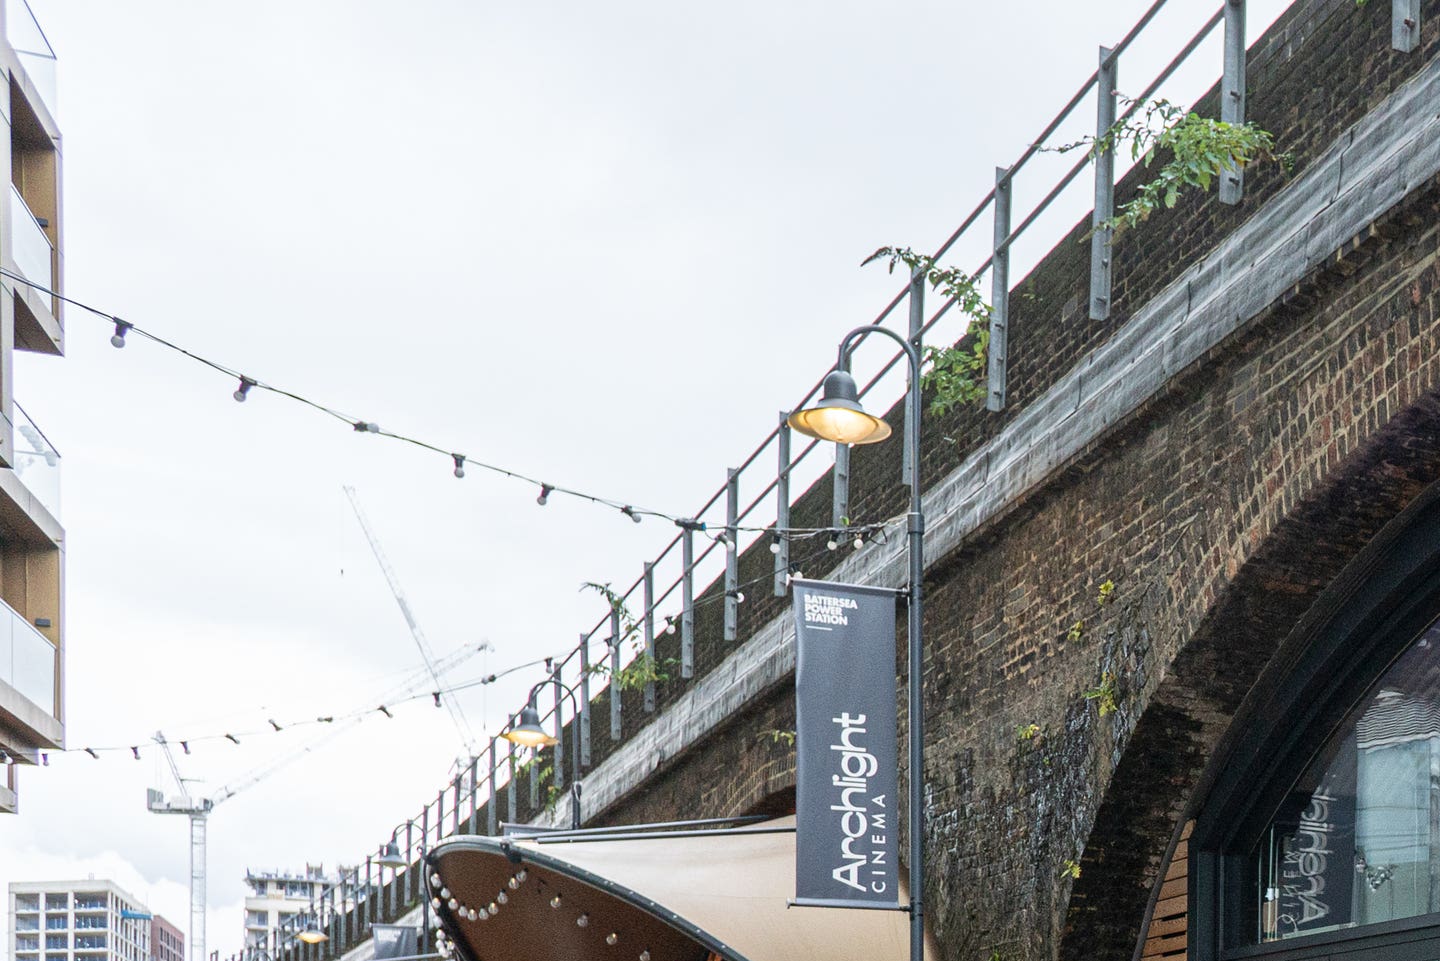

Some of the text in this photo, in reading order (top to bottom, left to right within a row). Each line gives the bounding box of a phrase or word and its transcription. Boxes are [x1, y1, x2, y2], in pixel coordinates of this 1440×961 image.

[804, 594, 858, 609] BATTERSEA
[804, 603, 843, 616] POWER
[804, 611, 849, 626] STATION
[830, 712, 879, 893] Archlight
[871, 794, 887, 893] CINEMA
